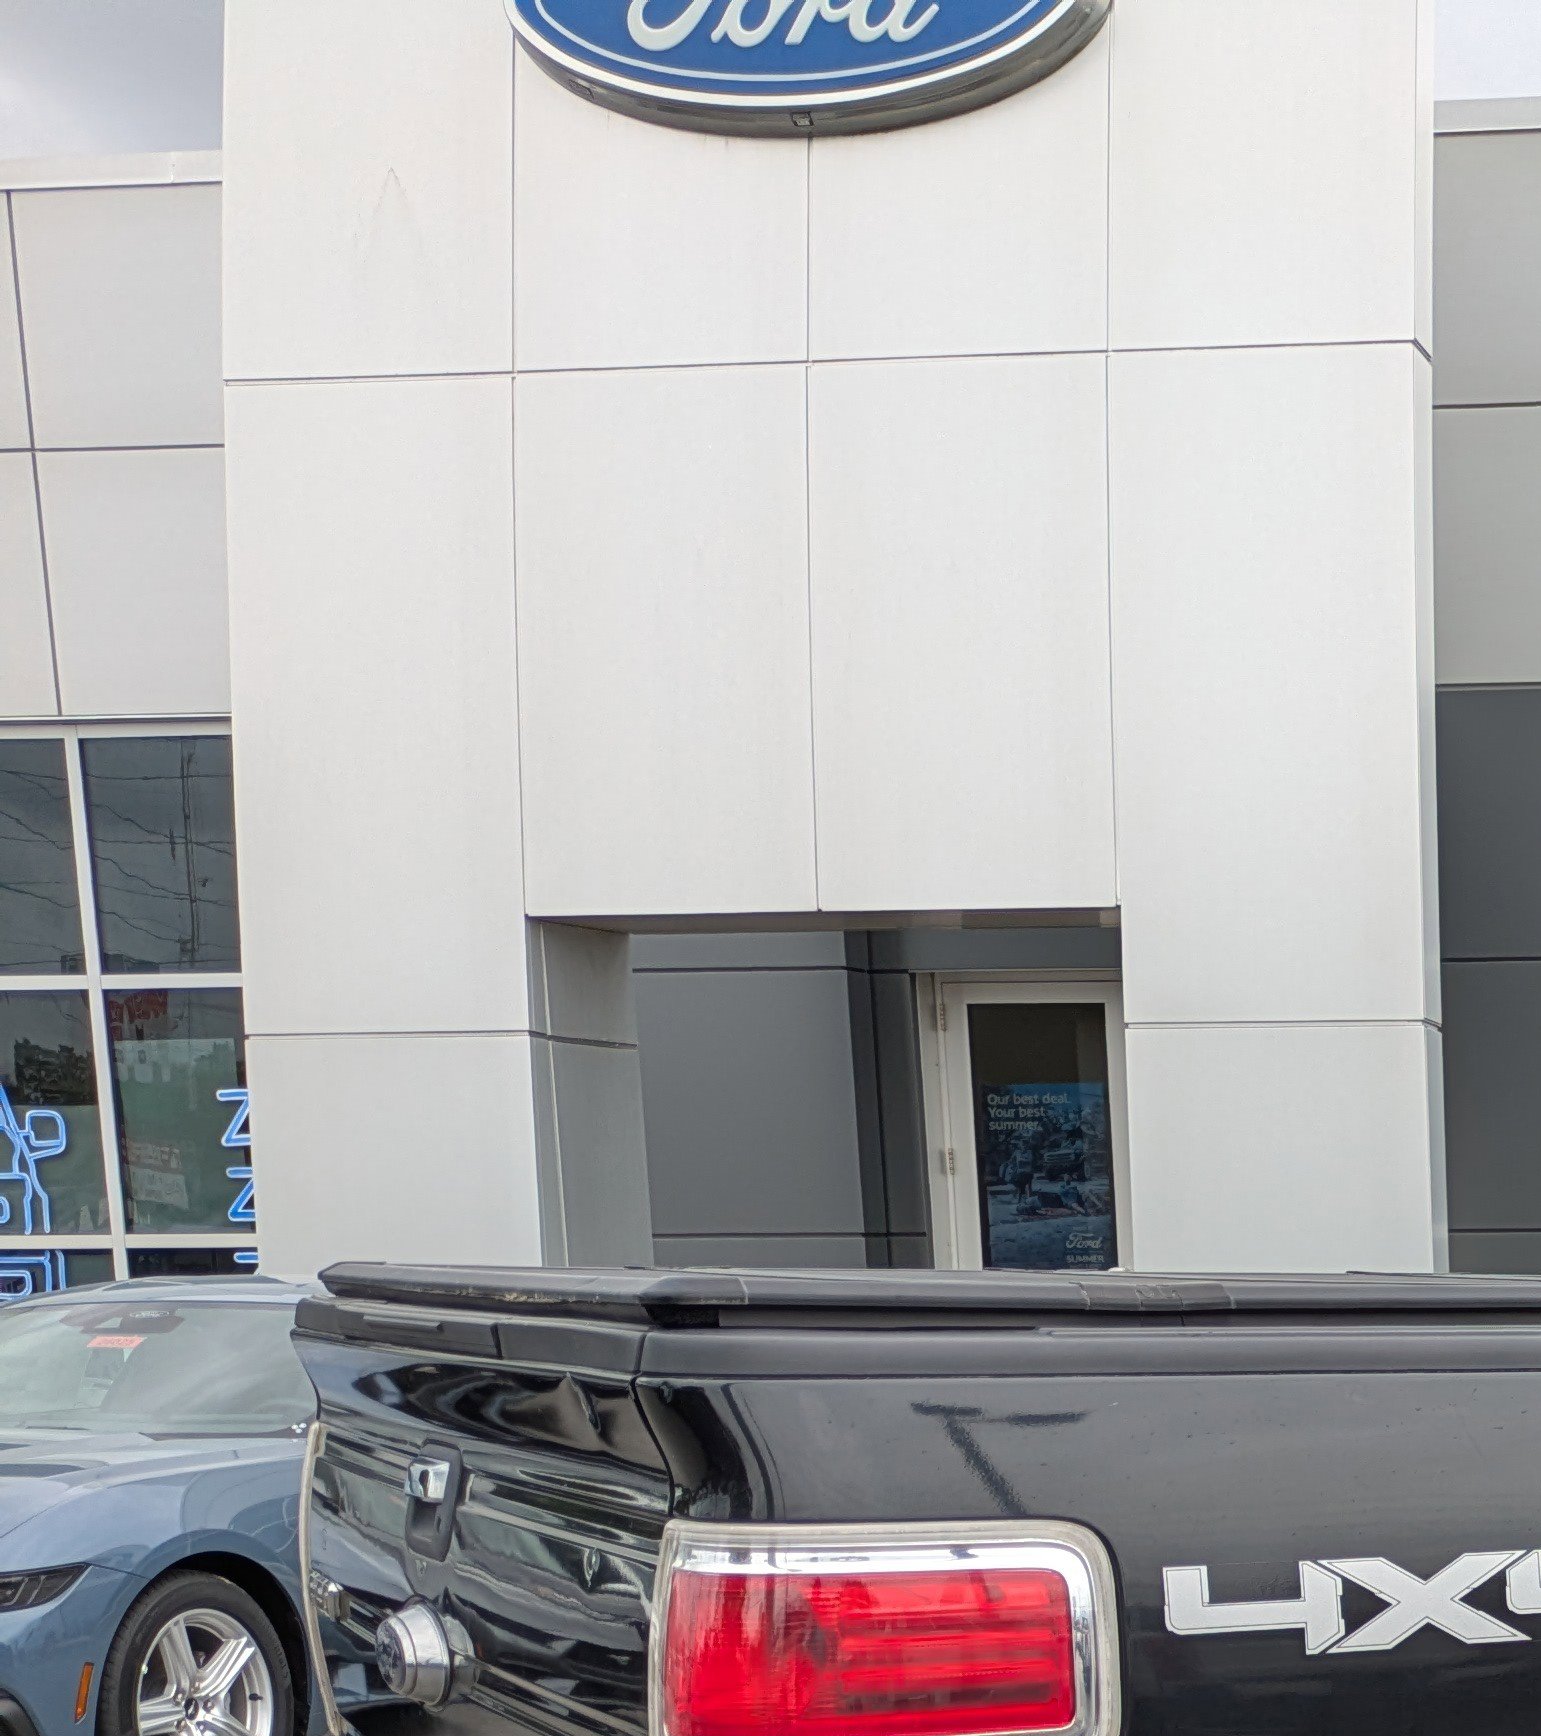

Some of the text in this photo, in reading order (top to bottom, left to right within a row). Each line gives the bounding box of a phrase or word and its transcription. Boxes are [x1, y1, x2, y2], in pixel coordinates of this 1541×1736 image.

[987, 1093, 1010, 1105] Our
[1013, 1092, 1040, 1105] best
[988, 1106, 1046, 1118] Your best
